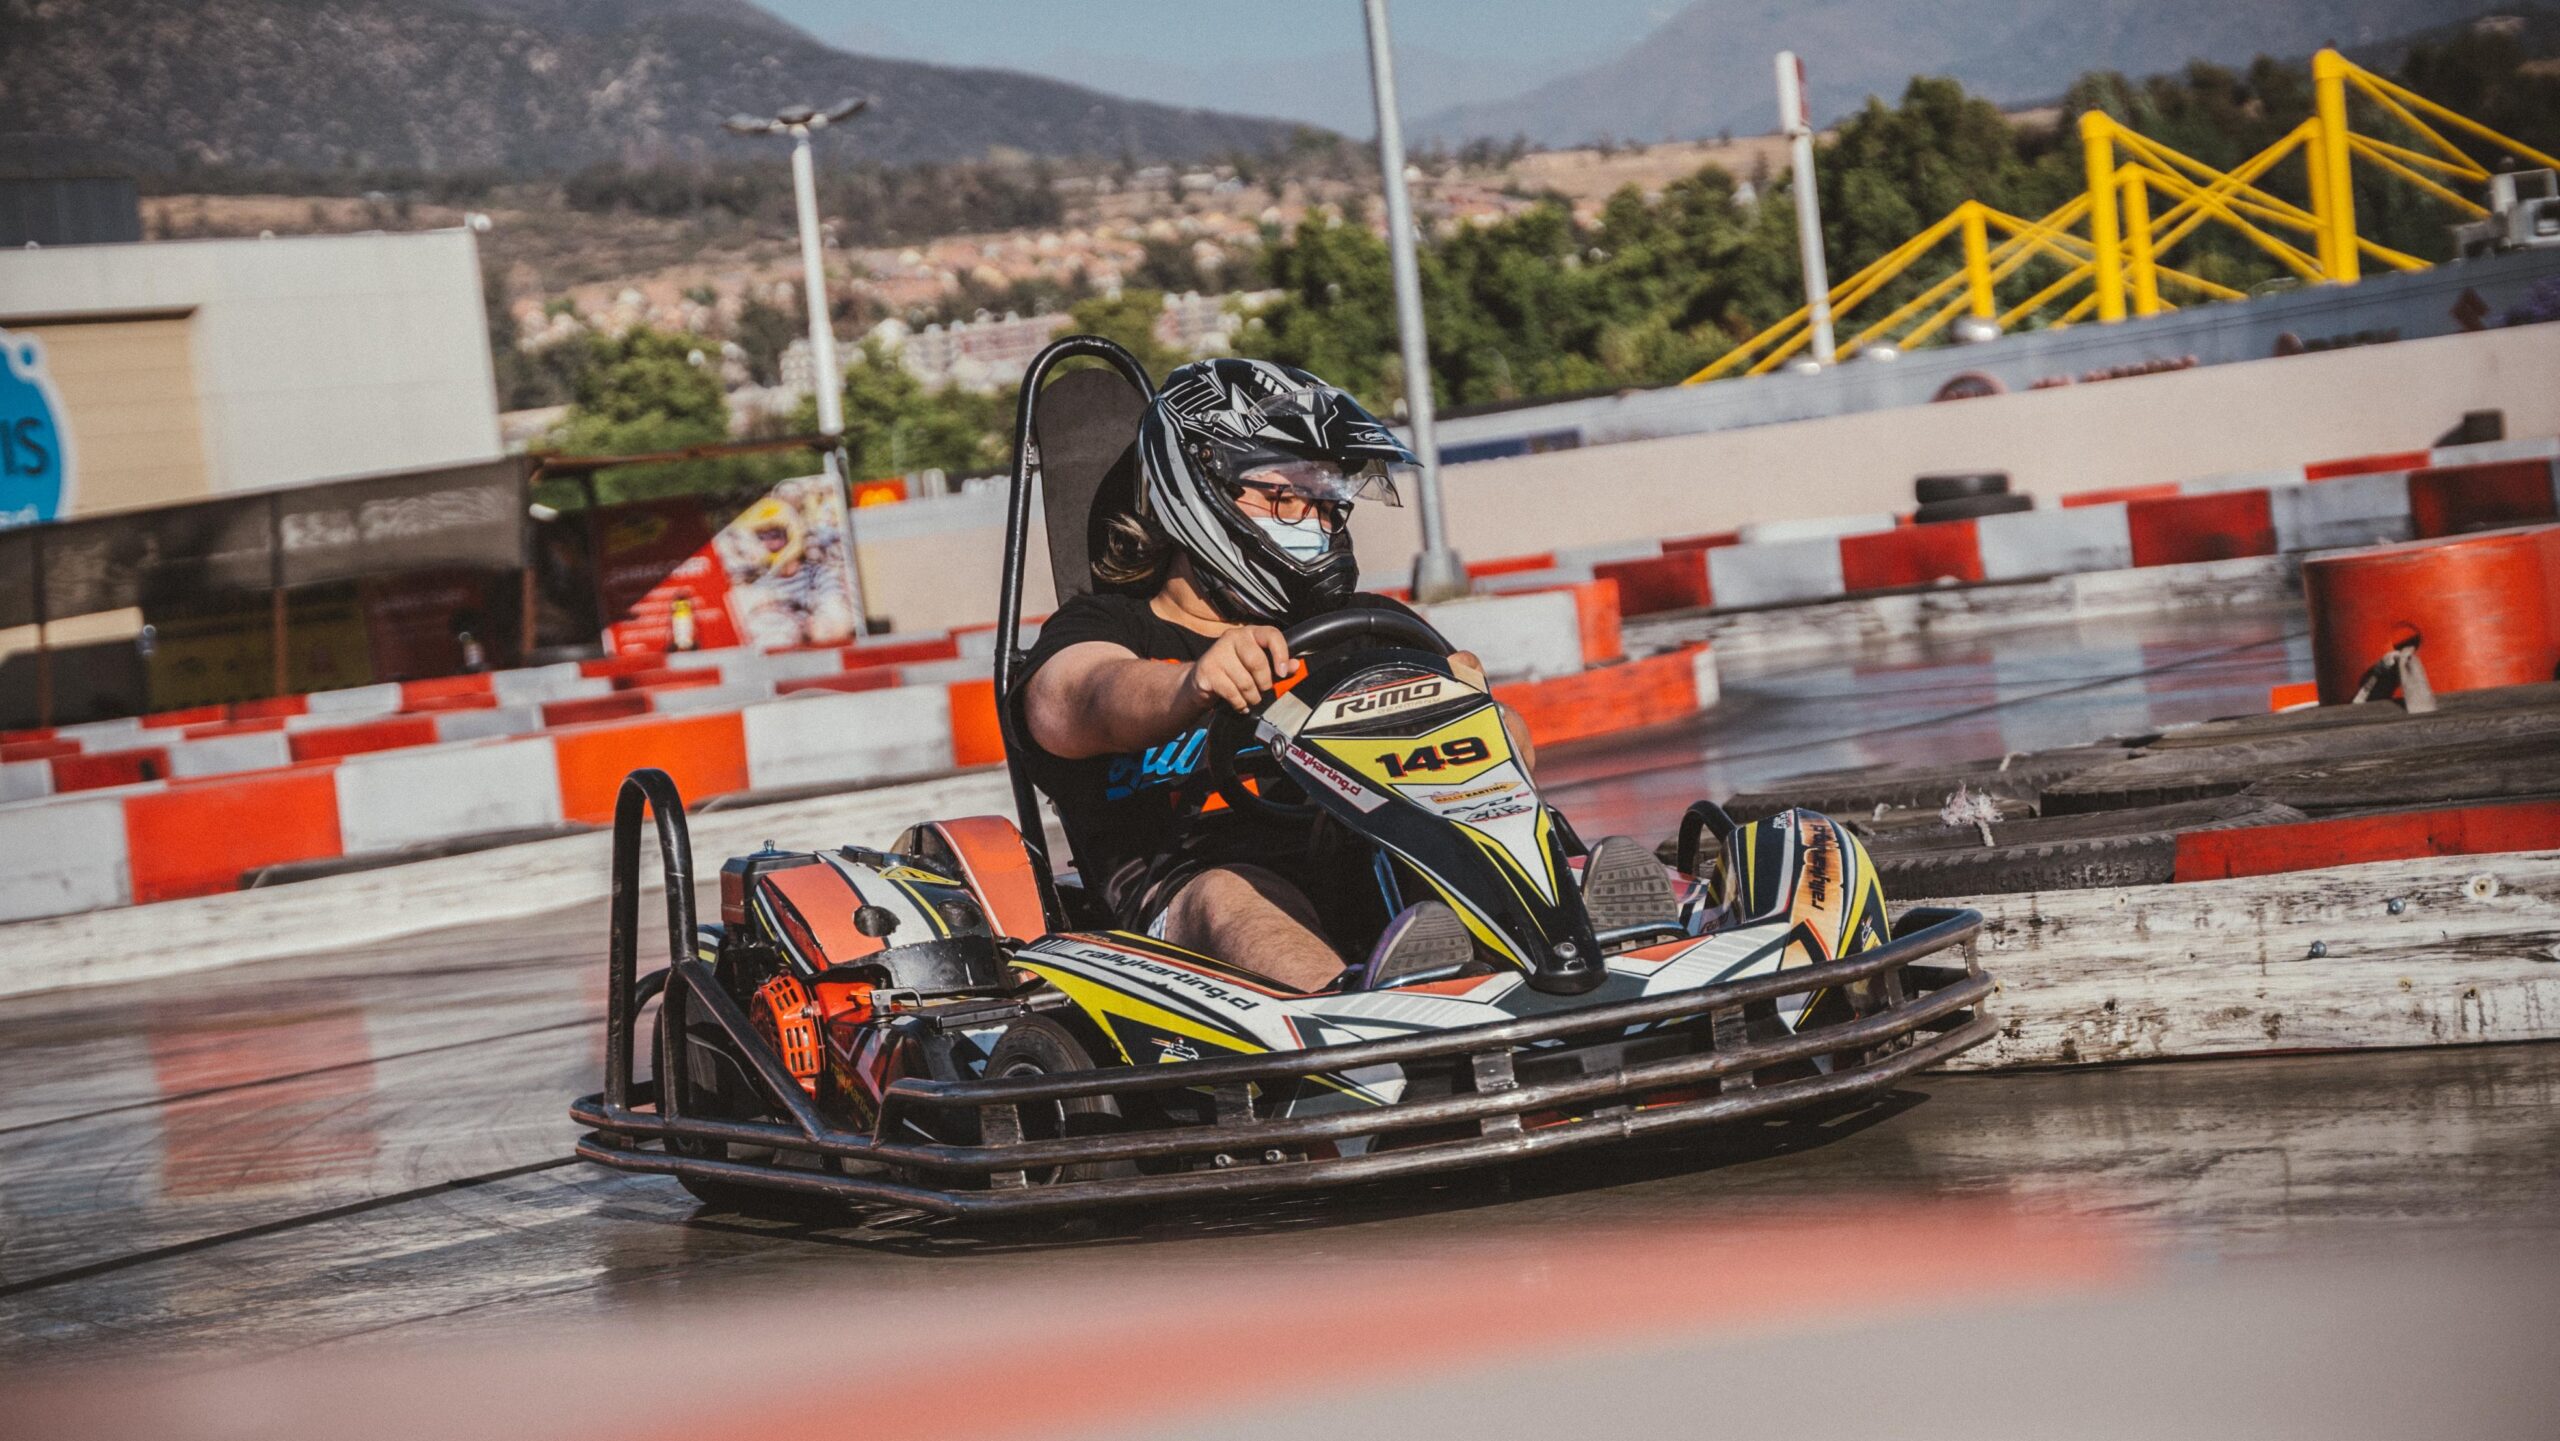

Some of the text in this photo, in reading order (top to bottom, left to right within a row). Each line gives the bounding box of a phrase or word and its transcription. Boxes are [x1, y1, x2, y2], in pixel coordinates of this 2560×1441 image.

[1286, 744, 1362, 796] rallykarting.cl
[1375, 736, 1492, 780] 149
[1466, 785, 1507, 798] KARTING
[1076, 949, 1261, 1011] rallykarting.cl
